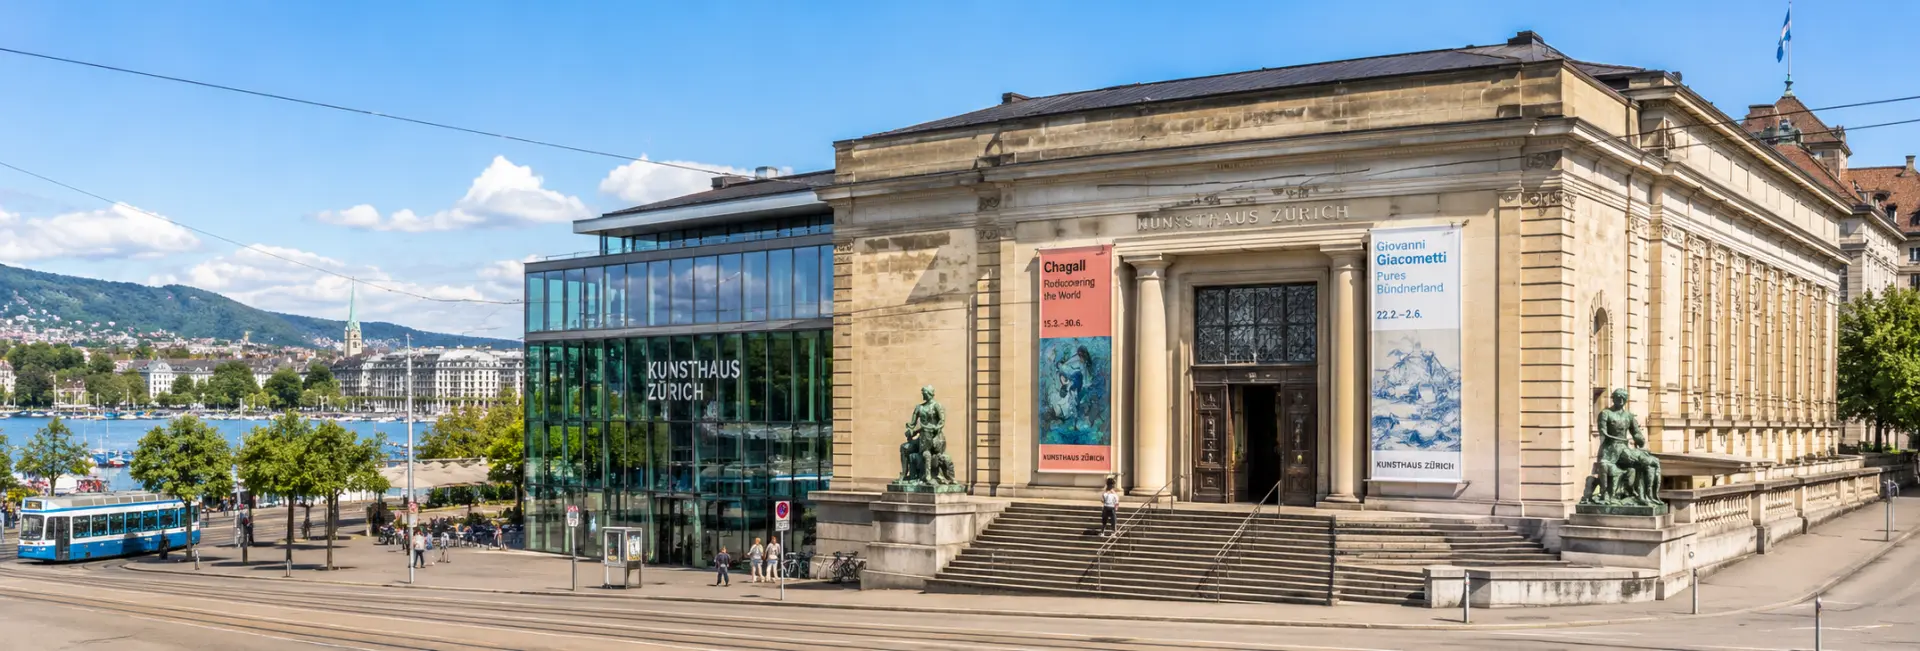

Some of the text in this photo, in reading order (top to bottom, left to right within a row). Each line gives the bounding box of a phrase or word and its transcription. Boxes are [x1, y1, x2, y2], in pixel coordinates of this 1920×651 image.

[1271, 205, 1349, 224] ZÜRICH
[1376, 240, 1426, 251] Giovanni
[1376, 251, 1447, 266] Giacometti
[1044, 259, 1086, 275] Chagall
[1376, 271, 1406, 281] Pures
[1376, 282, 1444, 295] Bündnerland
[1043, 290, 1081, 301] the World
[648, 360, 741, 379] KUNSTHAUS
[1376, 460, 1454, 470] KUNSTHAUS ZÜRICH
